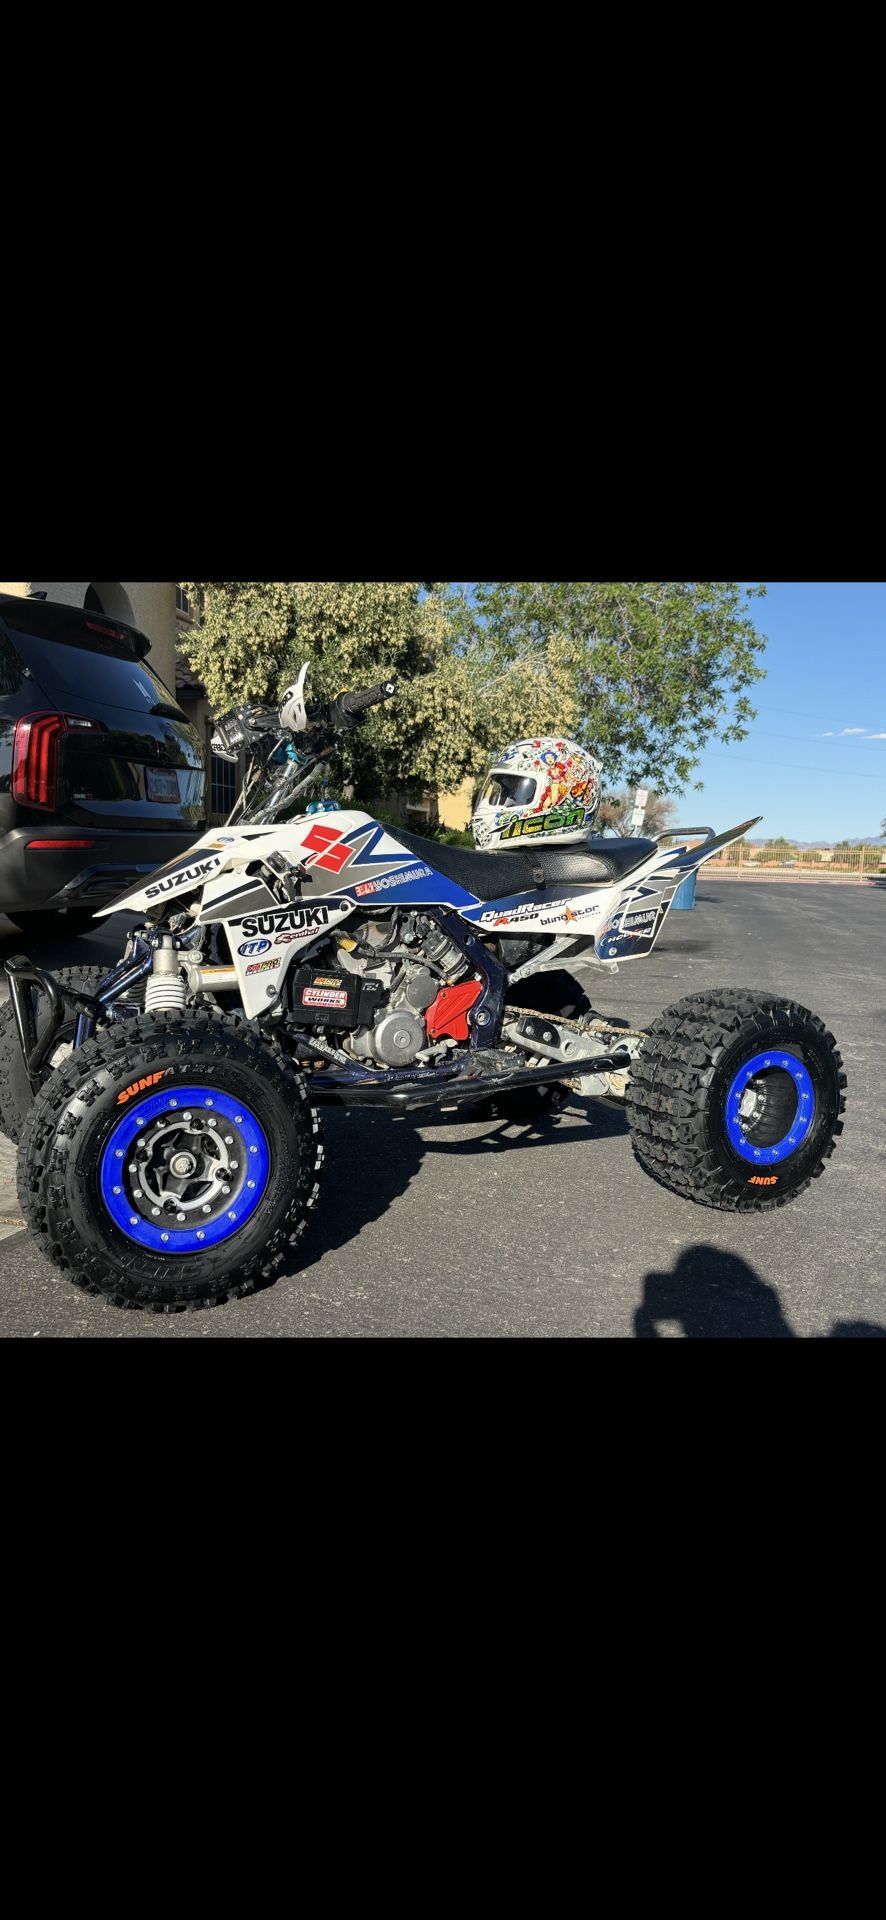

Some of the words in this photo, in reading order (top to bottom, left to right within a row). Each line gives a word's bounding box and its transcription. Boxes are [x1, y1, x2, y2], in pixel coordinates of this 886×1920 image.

[144, 858, 221, 899] SUZUKI
[373, 866, 434, 892] YOSHIMURA
[242, 906, 329, 937] SUZUKI
[480, 898, 573, 922] QuadRacer
[540, 914, 569, 926] bling
[240, 940, 269, 955] ITP
[305, 989, 346, 998] CYLINDER
[117, 1070, 166, 1105] SUNF
[747, 1176, 778, 1185] SUNF
